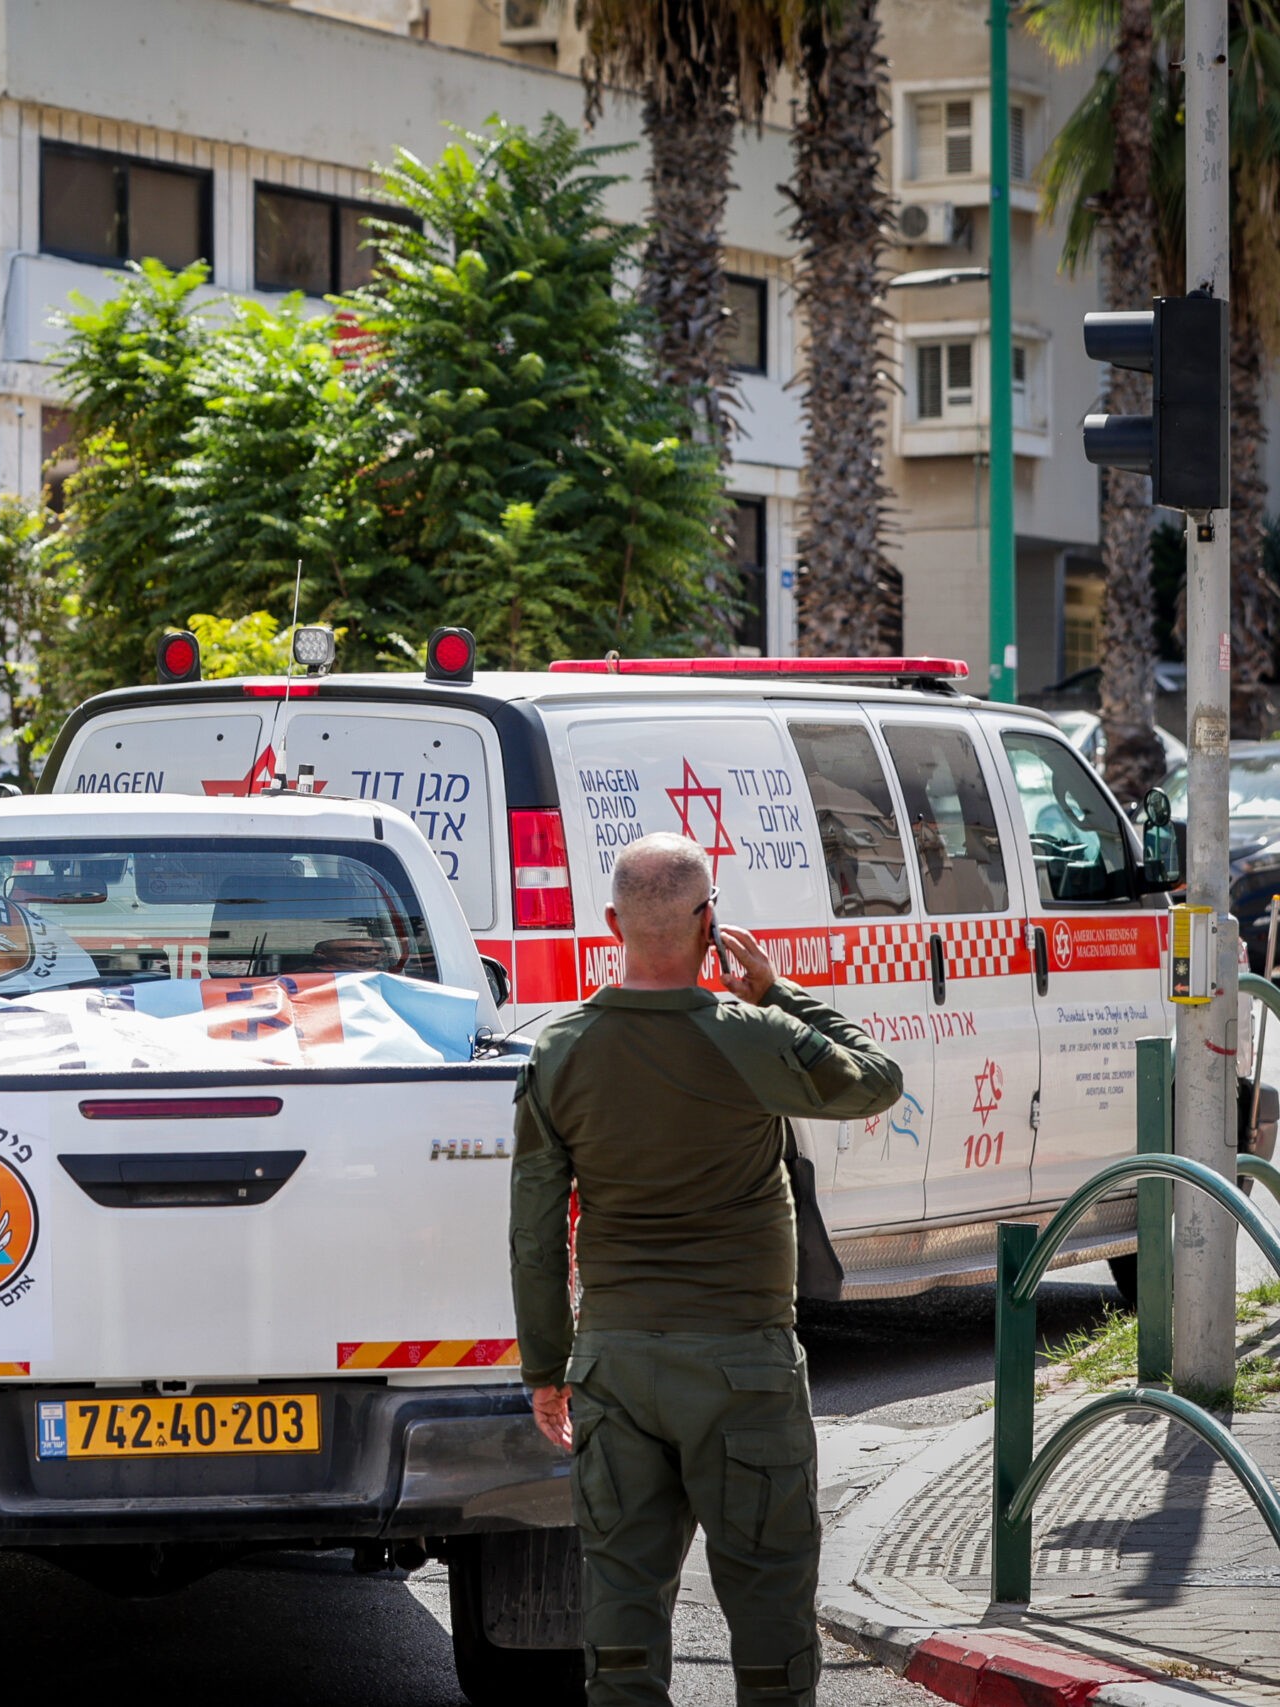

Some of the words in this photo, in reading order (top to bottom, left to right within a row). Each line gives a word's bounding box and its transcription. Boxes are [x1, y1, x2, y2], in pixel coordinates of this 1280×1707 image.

[75, 771, 164, 793] MAGEN
[351, 771, 405, 800] דוד
[416, 772, 470, 807] מגן
[579, 769, 640, 793] MAGEN
[728, 769, 760, 796] דוד
[762, 769, 792, 801] מגן
[586, 796, 637, 819] DAVID
[758, 805, 803, 832] אדום
[595, 822, 644, 847] ADOM
[740, 836, 810, 870] בישראל
[1073, 929, 1105, 942] AMERICAN
[1106, 928, 1130, 941] FRIENDS
[1130, 927, 1138, 940] OF
[795, 936, 829, 975] ADOM
[1076, 944, 1100, 957] MAGEN
[1100, 944, 1119, 956] DAVID
[1119, 944, 1137, 956] ADOM
[929, 1011, 977, 1044] ארגון
[963, 1131, 1004, 1169] 101
[0, 1274, 36, 1307] אתם
[44, 1419, 61, 1441] IL
